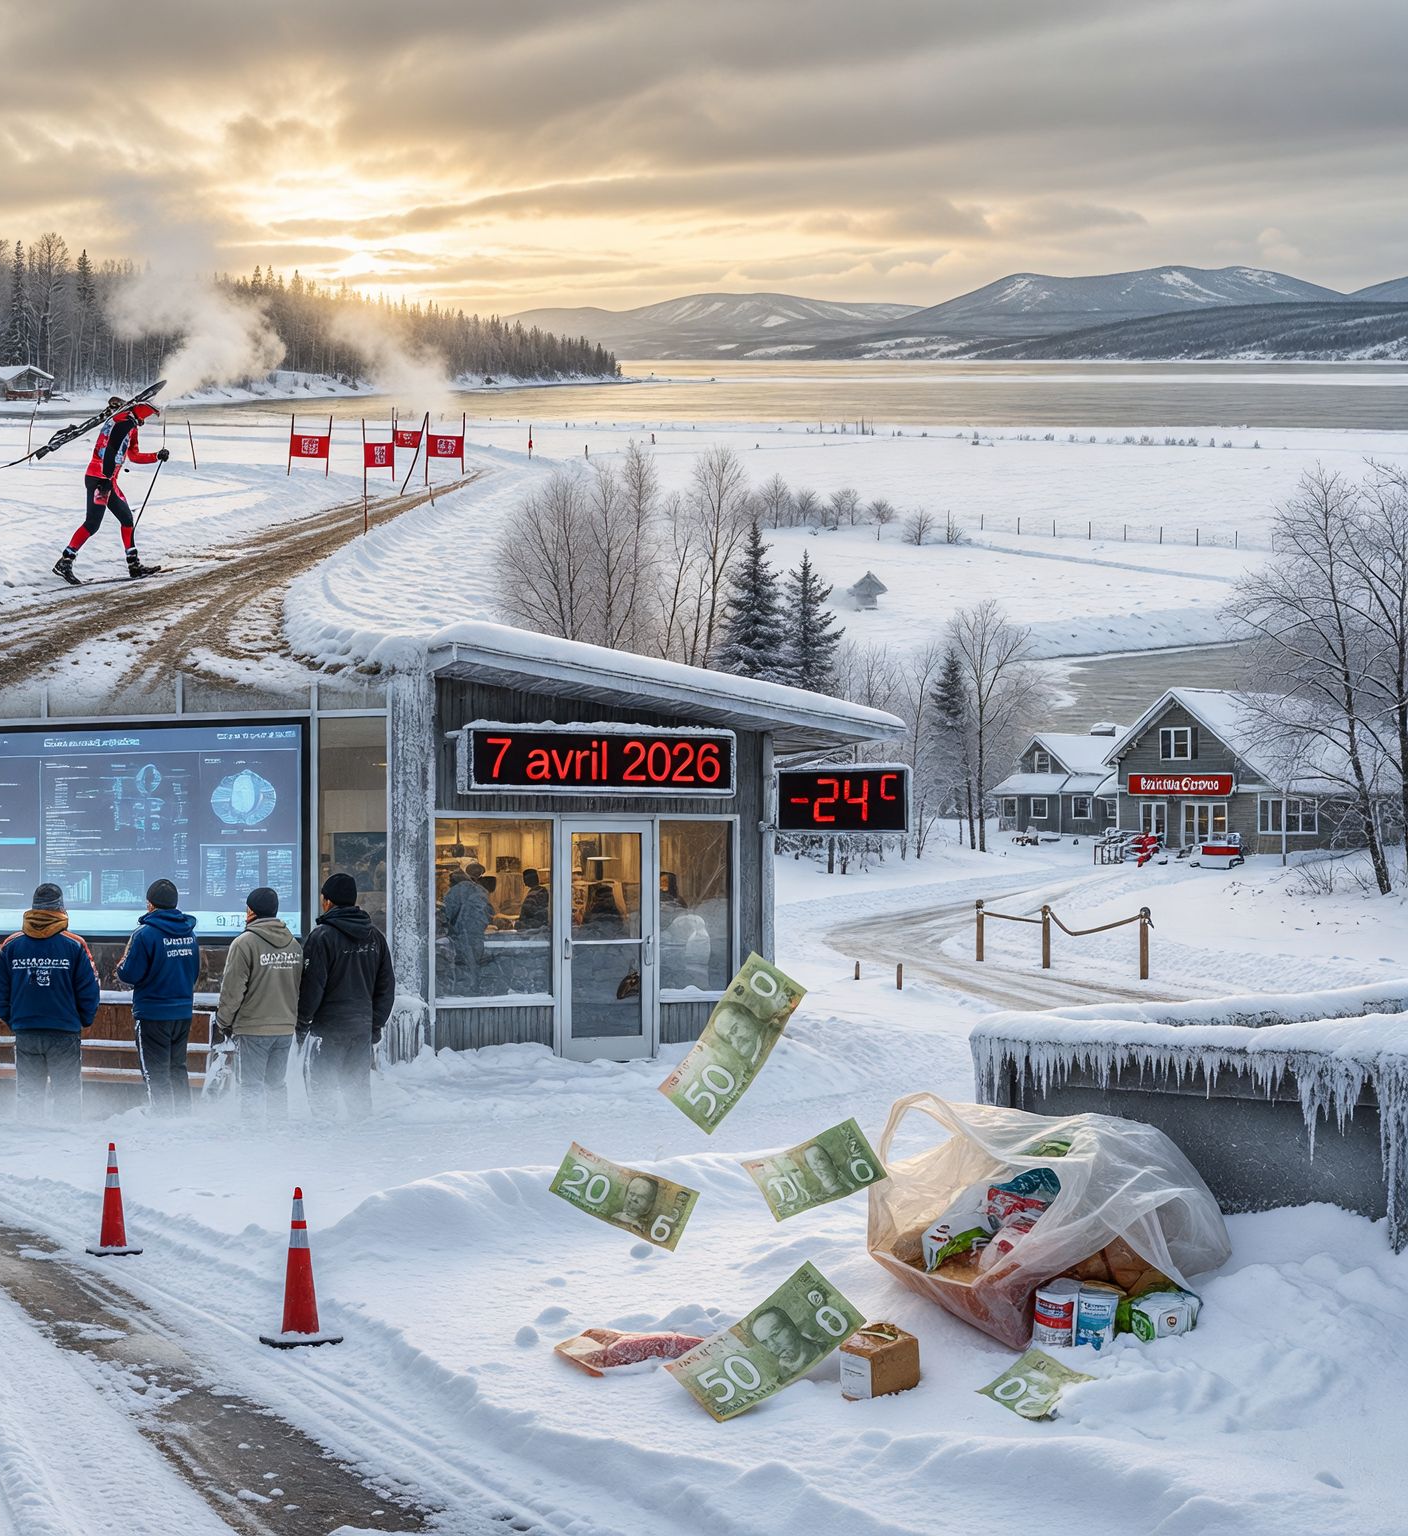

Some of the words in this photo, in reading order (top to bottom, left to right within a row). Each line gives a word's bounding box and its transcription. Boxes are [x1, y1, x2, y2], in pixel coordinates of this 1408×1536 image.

[486, 737, 512, 778] 7
[525, 740, 608, 781] avril
[622, 740, 721, 783] 2026
[683, 1063, 736, 1119] 50
[561, 1164, 612, 1205] 20
[696, 1354, 763, 1404] 50
